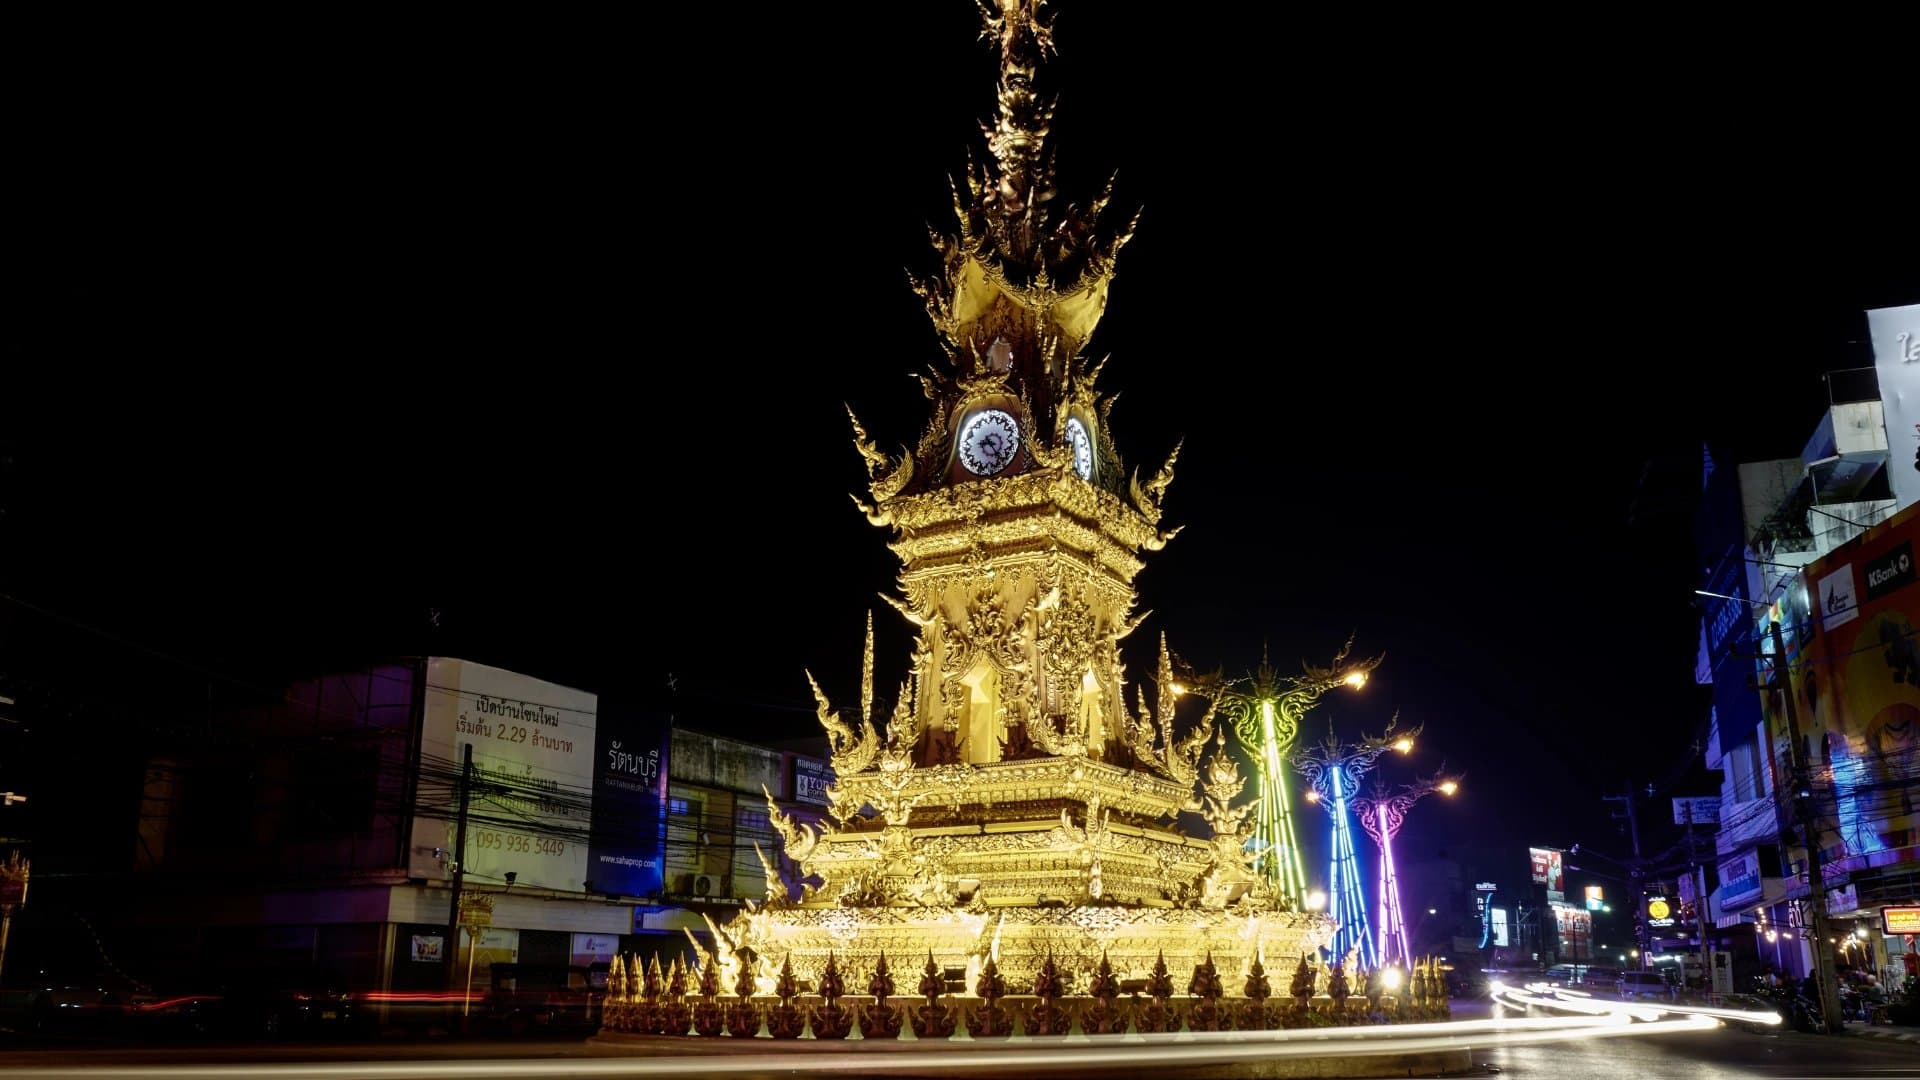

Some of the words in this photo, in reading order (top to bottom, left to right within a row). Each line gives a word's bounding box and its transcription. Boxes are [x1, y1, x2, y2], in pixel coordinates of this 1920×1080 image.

[1868, 560, 1898, 588] KBank
[456, 711, 492, 738] เริ่มต้น
[497, 723, 527, 743] 2.29
[531, 728, 573, 753] ล้านบาท
[608, 739, 659, 787] รัตนบุรี
[477, 831, 502, 849] 095
[506, 835, 530, 853] 936
[534, 838, 565, 857] 5449
